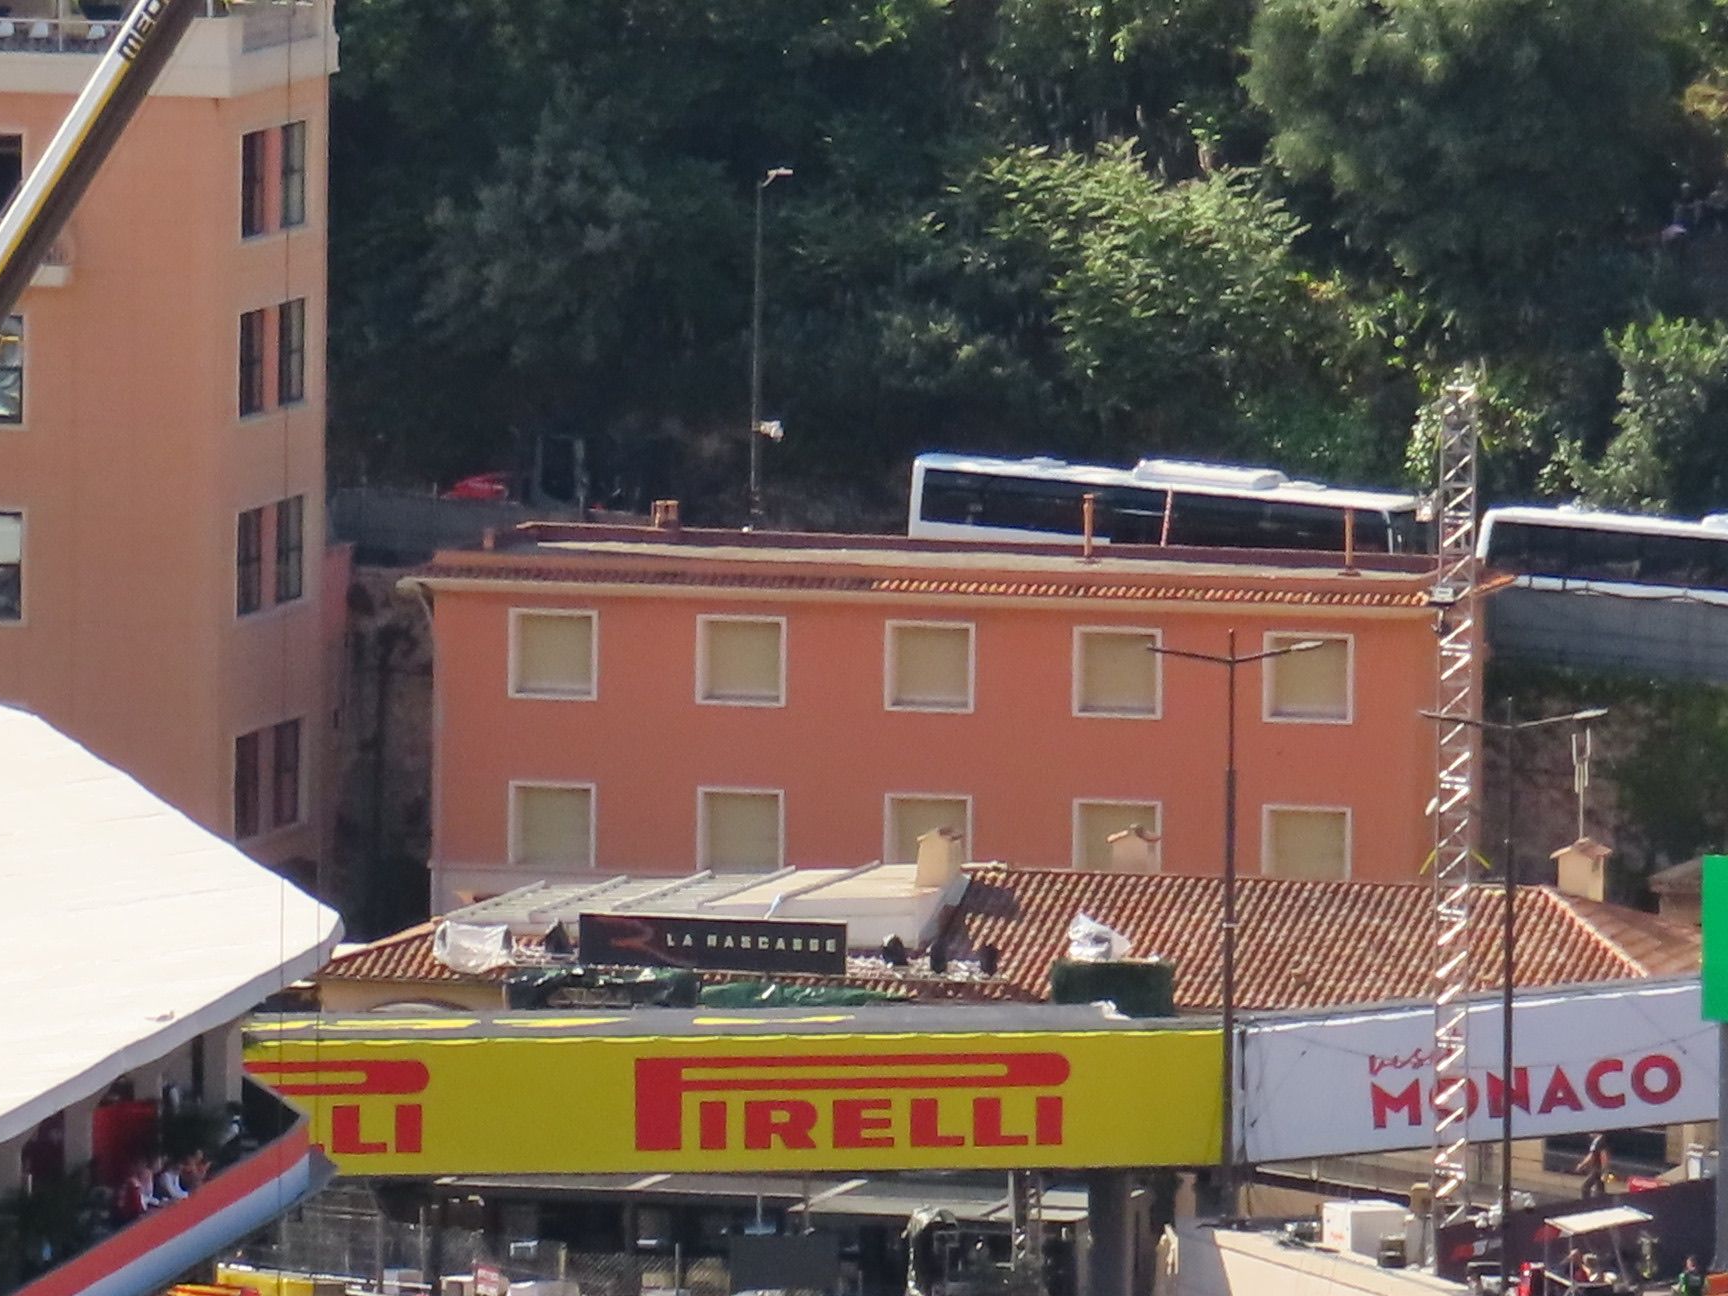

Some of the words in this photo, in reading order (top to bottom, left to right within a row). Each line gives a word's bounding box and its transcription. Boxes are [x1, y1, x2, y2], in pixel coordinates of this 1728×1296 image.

[666, 931, 693, 949] LA
[635, 1052, 1070, 1152] PIRELLI
[1371, 1054, 1682, 1131] MONACO
